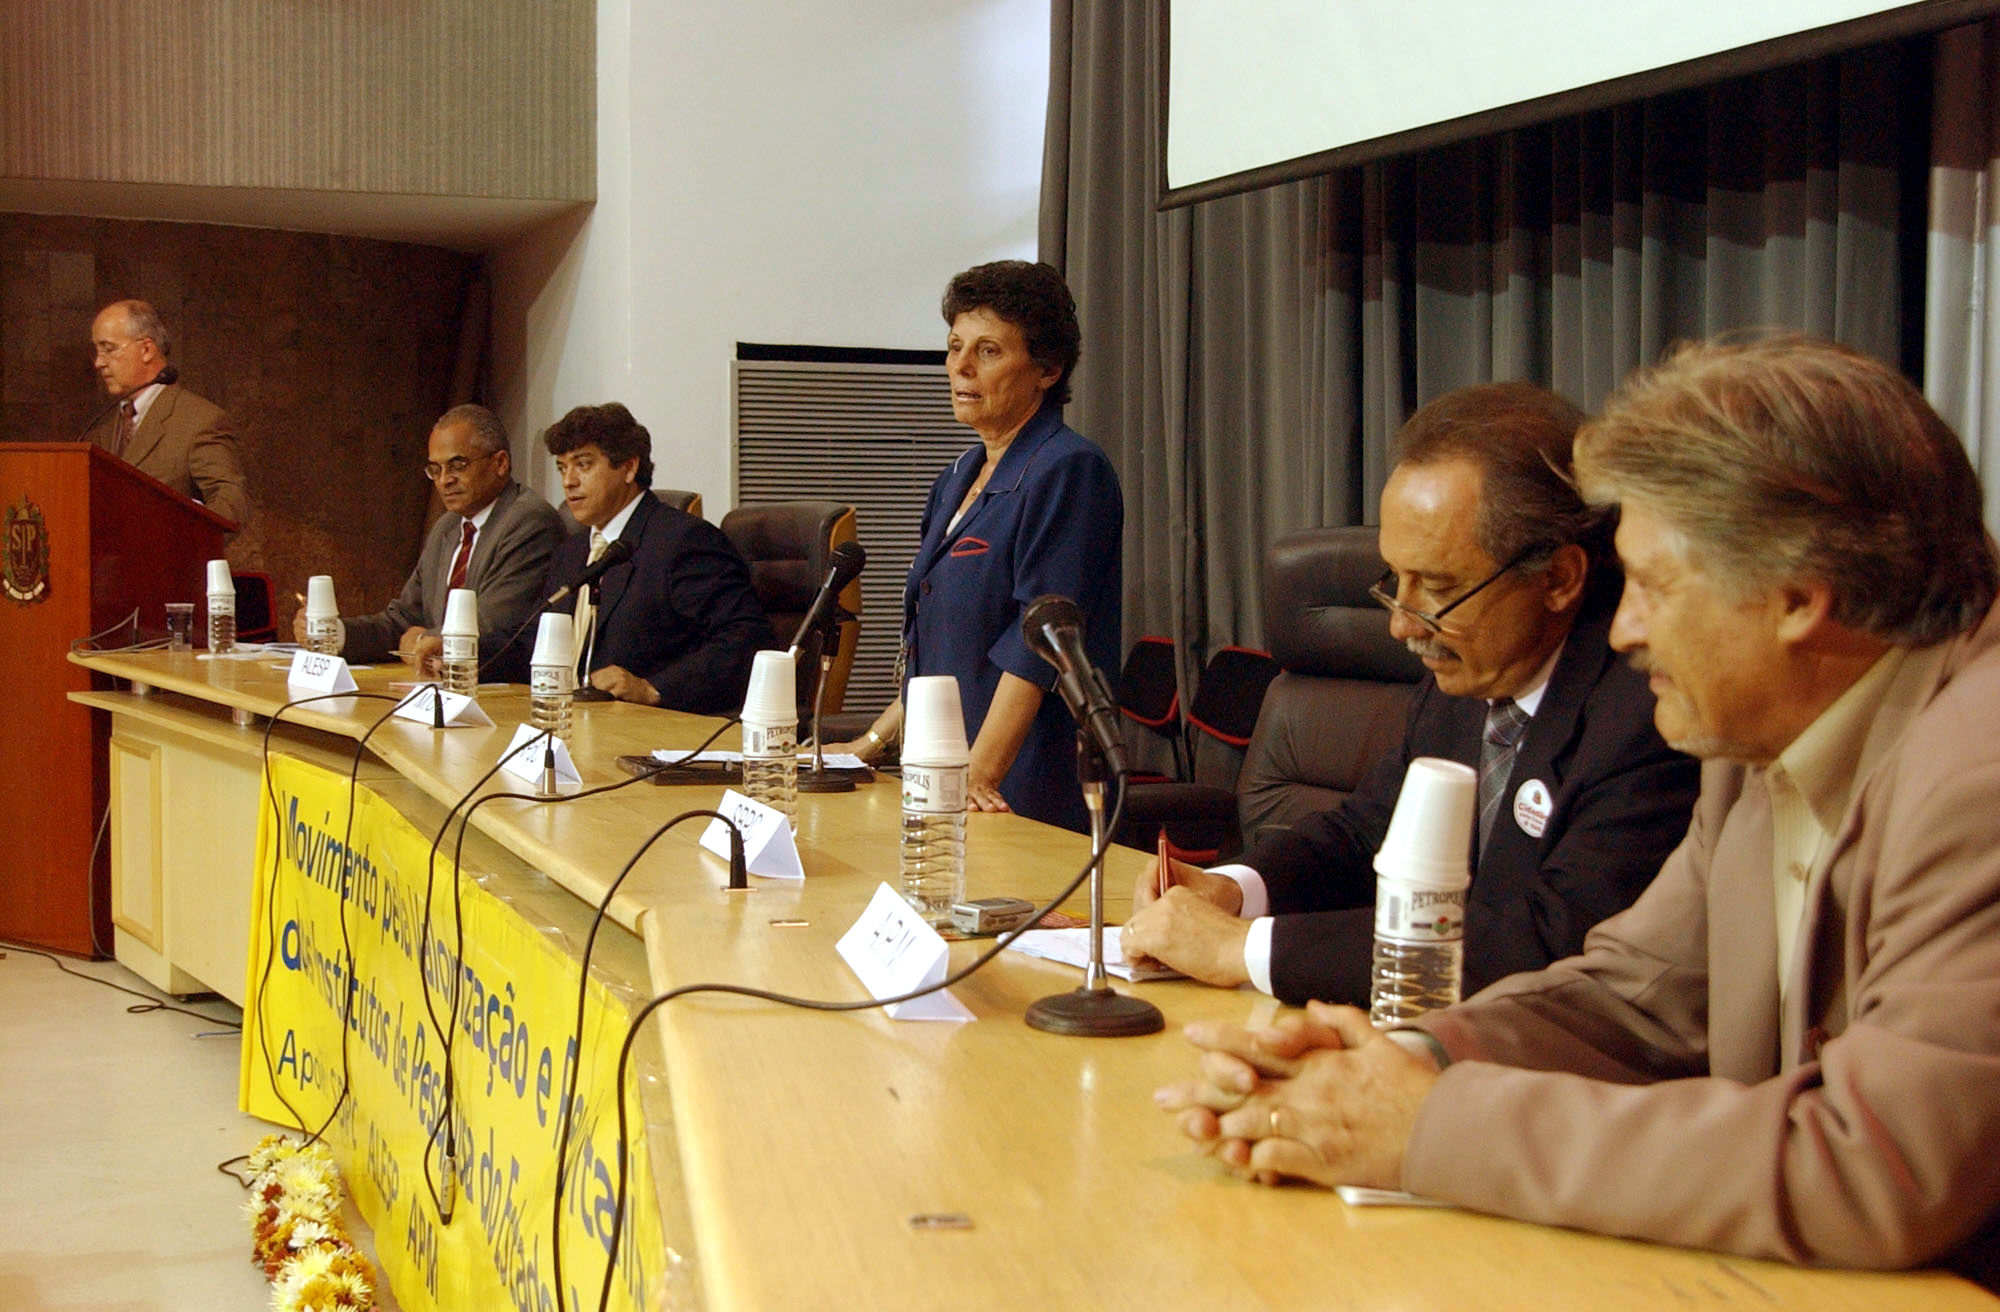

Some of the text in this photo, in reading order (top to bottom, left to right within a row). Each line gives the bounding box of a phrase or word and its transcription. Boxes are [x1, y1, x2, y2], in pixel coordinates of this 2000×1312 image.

[301, 655, 331, 677] ALESP
[281, 790, 378, 920] Movimento
[407, 884, 528, 1099] Valorização
[537, 1046, 552, 1128] e
